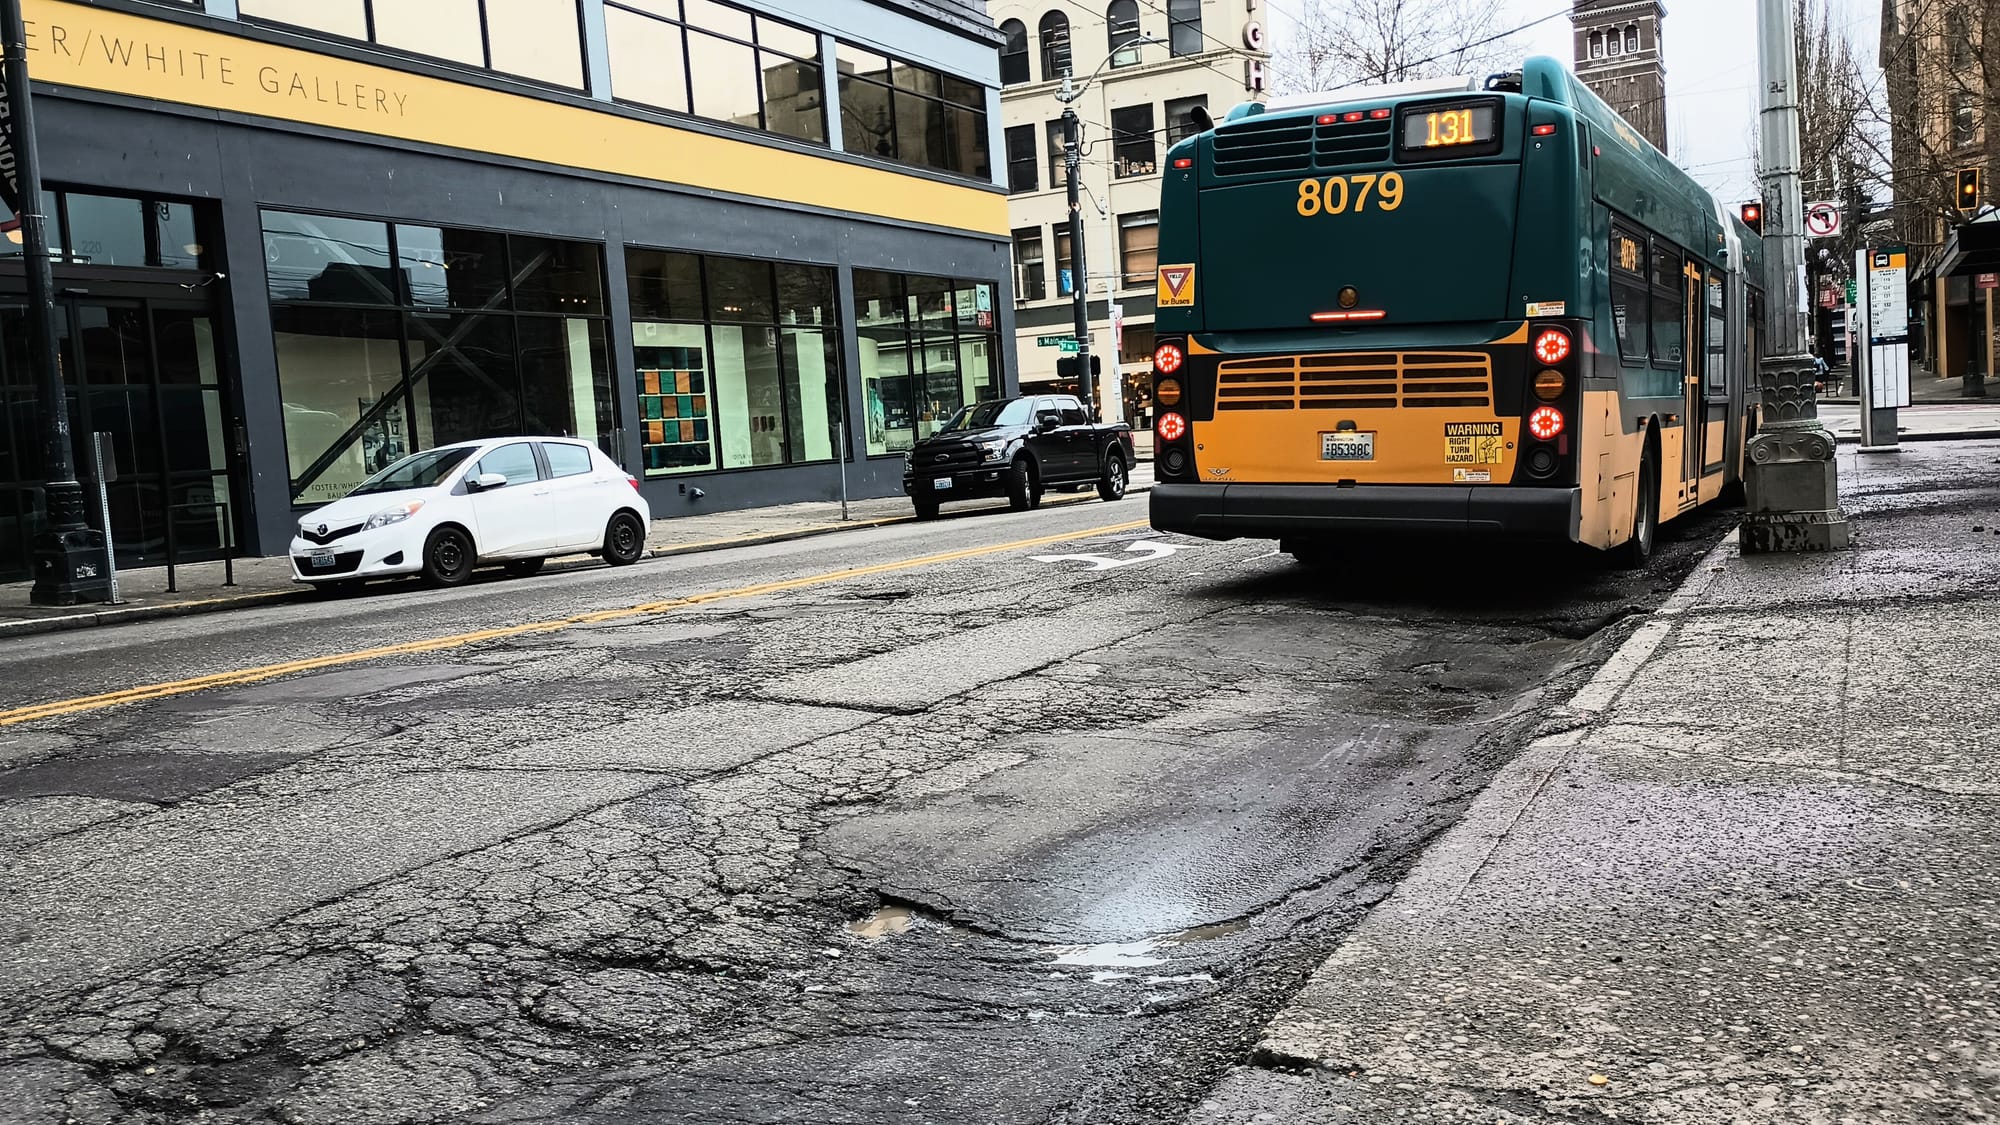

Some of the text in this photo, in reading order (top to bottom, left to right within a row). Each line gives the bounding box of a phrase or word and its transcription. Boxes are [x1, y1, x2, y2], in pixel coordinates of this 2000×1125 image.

[258, 66, 407, 117] GALLERY
[1426, 109, 1475, 146] 131
[1297, 171, 1404, 217] 8079
[1621, 236, 1636, 272] 8079
[1044, 337, 1059, 345] Main
[1447, 423, 1500, 435] WARNING
[1449, 437, 1471, 445] RIGHT
[1331, 443, 1370, 456] B5398C
[1450, 446, 1470, 454] TURN
[1446, 454, 1474, 463] HAZARD
